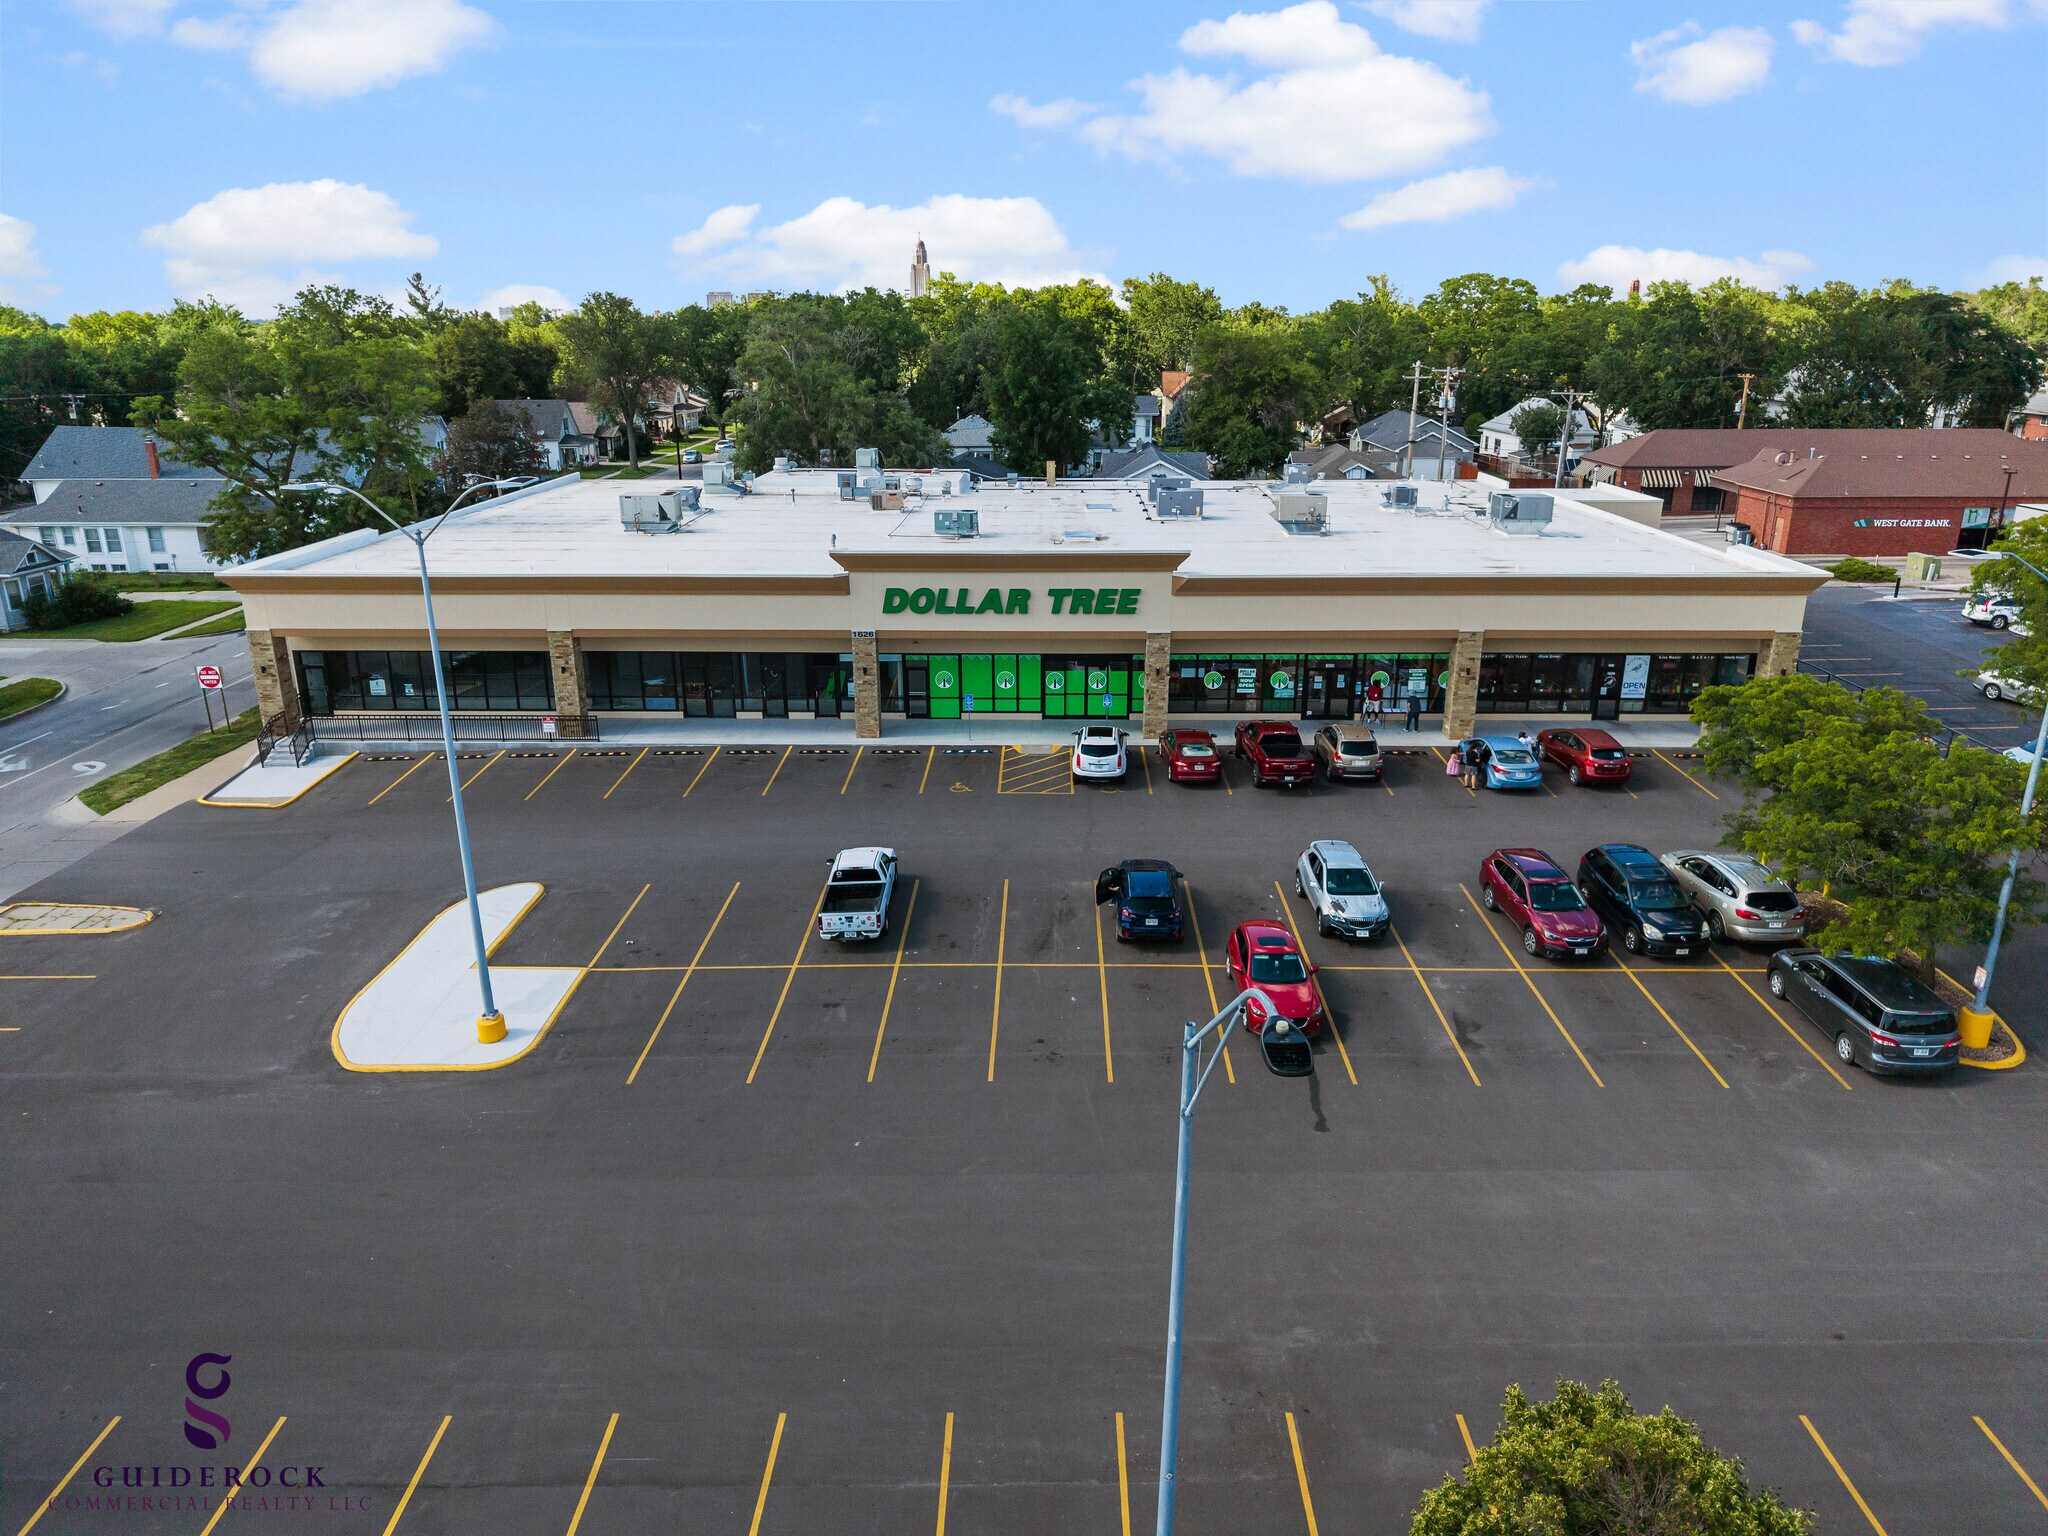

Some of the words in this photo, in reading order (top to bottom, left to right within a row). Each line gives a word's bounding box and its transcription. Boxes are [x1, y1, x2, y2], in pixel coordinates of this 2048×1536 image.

[1873, 519, 1898, 527] WEST
[1900, 519, 1922, 527] GATE
[882, 587, 1031, 614] DOLLAR
[1047, 588, 1141, 614] TREE
